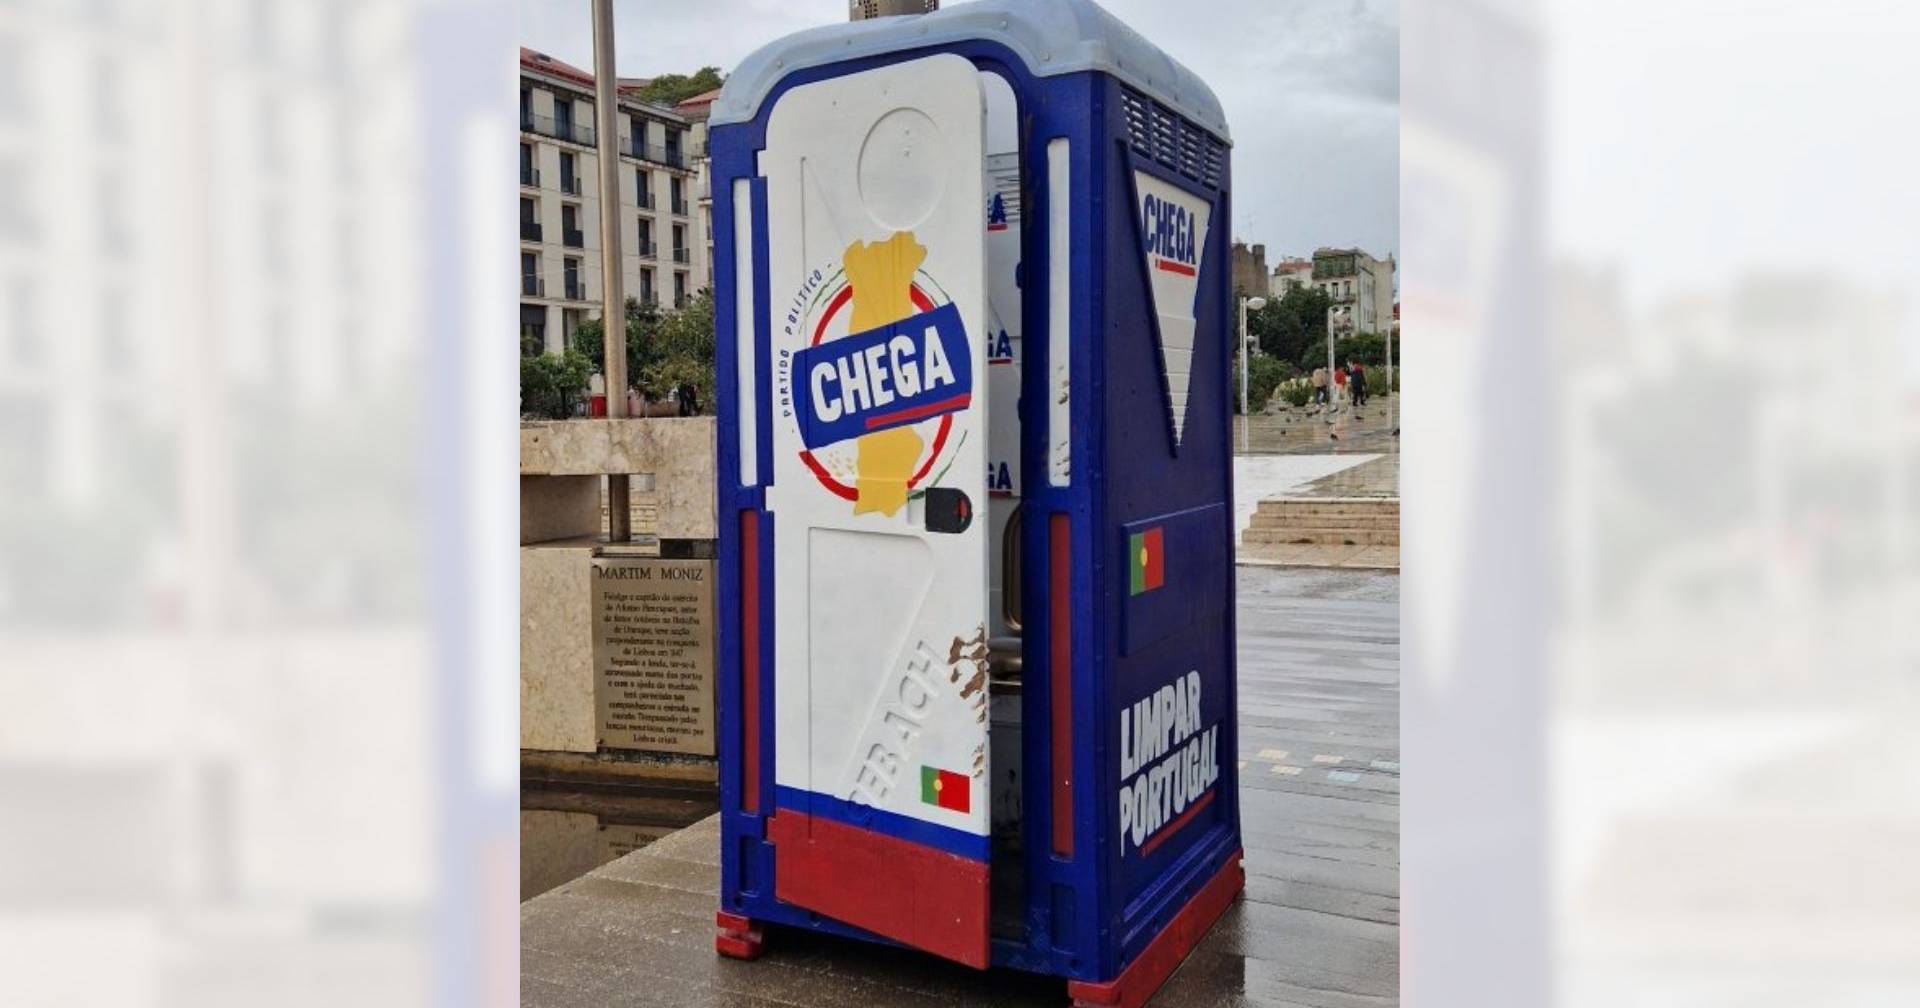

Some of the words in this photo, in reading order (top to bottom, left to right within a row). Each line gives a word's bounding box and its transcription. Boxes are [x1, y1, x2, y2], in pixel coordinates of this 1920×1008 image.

[1143, 193, 1196, 265] CHEGA
[779, 349, 793, 418] PARTIDO
[811, 325, 956, 423] CHEGA
[599, 567, 652, 580] MARTIM
[660, 567, 704, 581] MONIZ
[1120, 670, 1201, 782] LIMPAR
[1119, 724, 1219, 857] PORTUGAL
